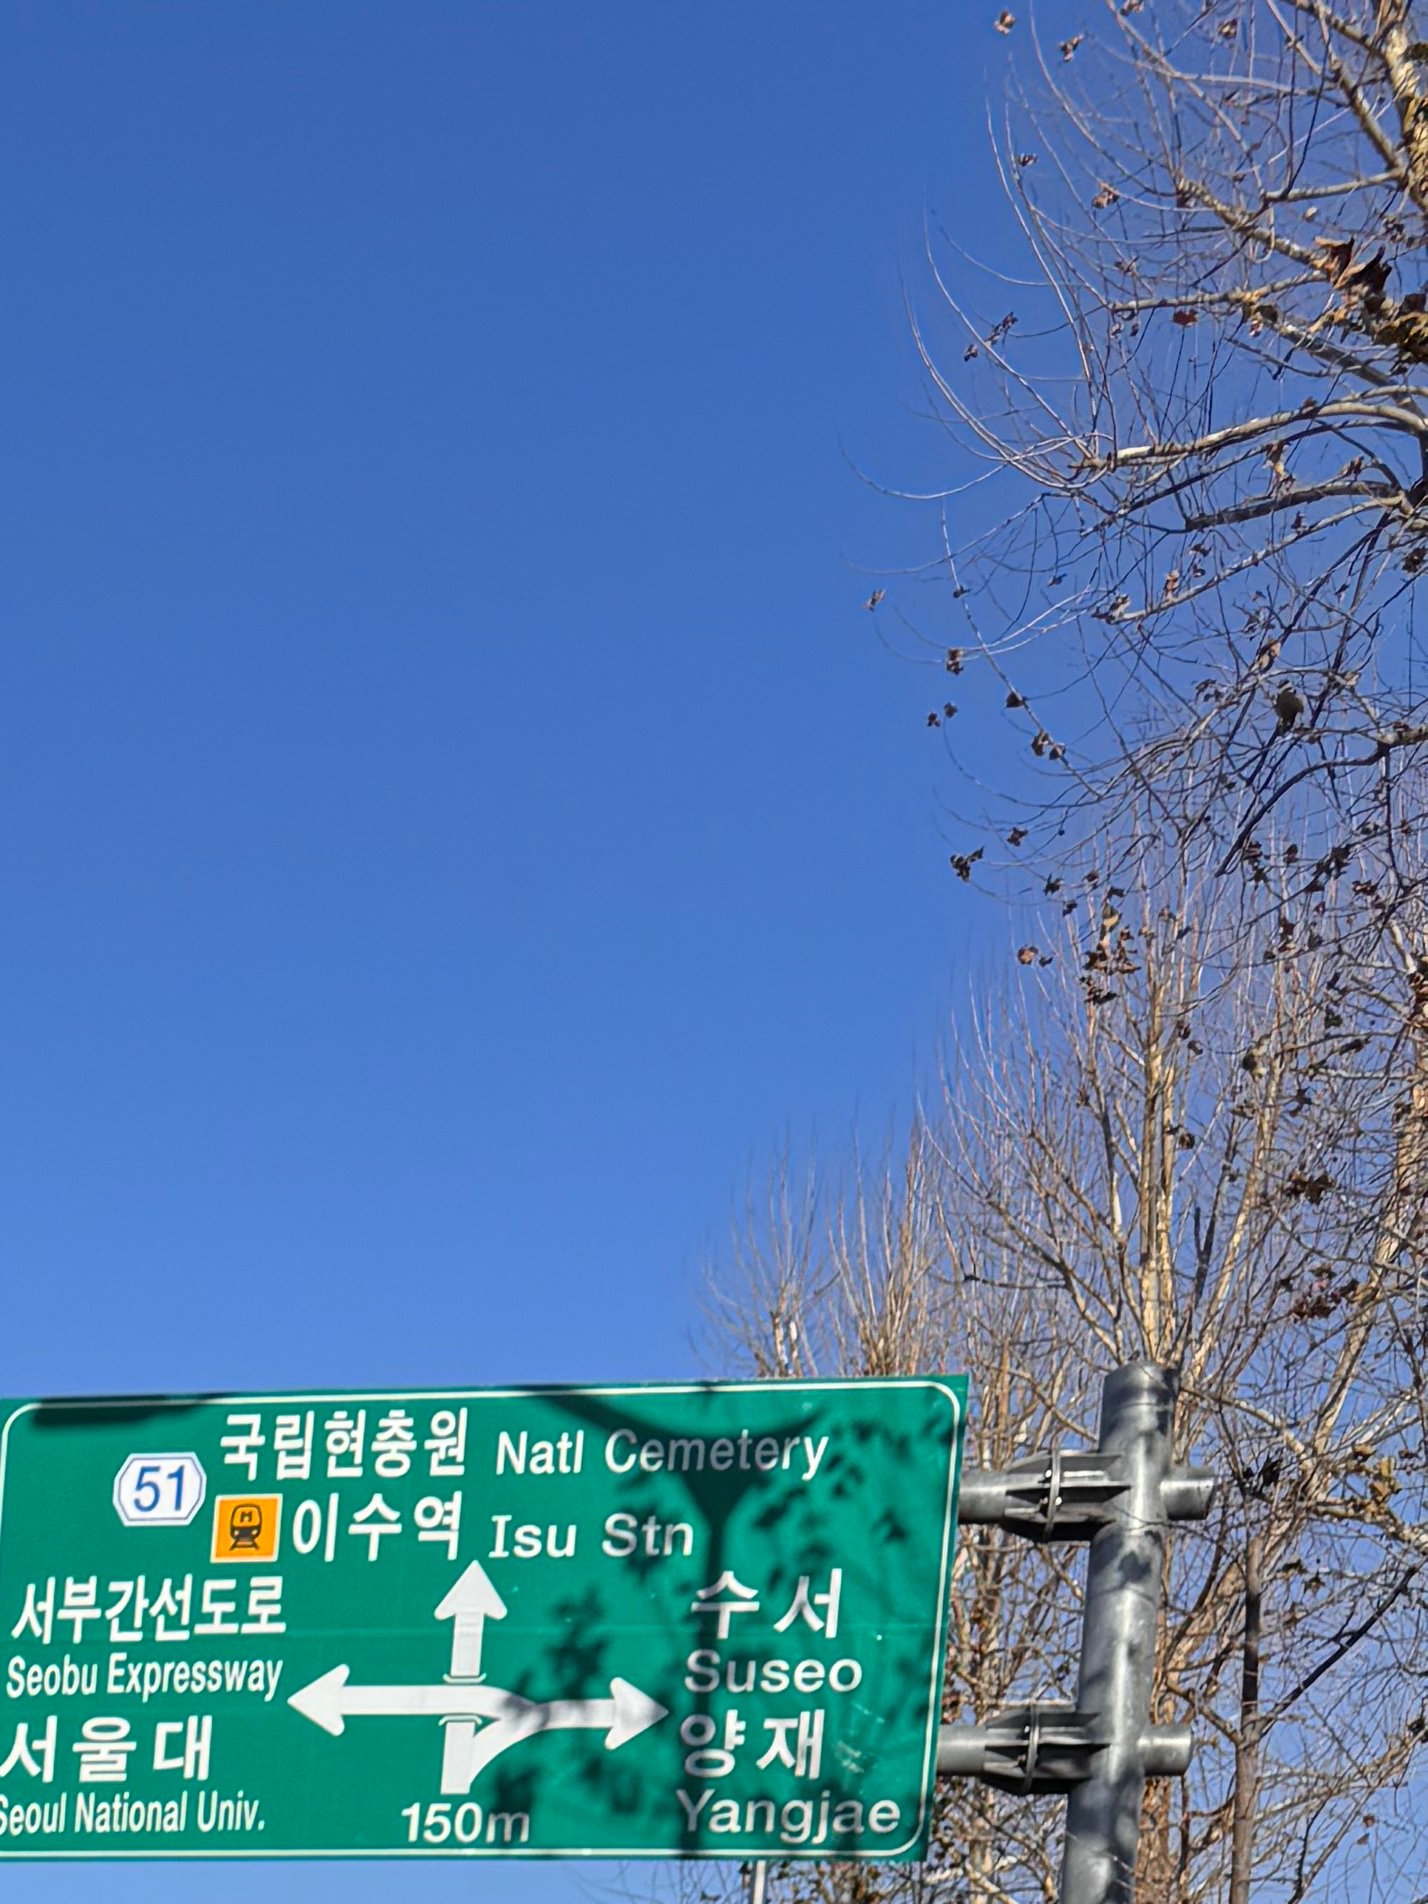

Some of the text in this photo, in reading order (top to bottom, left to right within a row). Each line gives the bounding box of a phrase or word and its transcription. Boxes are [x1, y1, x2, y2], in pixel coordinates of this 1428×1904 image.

[221, 1407, 467, 1480] 국립현충원
[497, 1429, 829, 1481] Natl Cemetery
[132, 1469, 190, 1515] 51
[293, 1491, 464, 1561] 이수역
[490, 1513, 693, 1558] Isu Stn
[11, 1574, 286, 1644] 서부간선도로
[691, 1568, 842, 1640] 수서
[7, 1653, 283, 1701] Seobu Expressway
[684, 1650, 862, 1694] Suseo
[681, 1709, 824, 1779] 양재
[74, 1791, 187, 1833] National
[196, 1789, 265, 1833] Univ.
[401, 1802, 530, 1844] 150m
[677, 1789, 900, 1845] Yangjae
